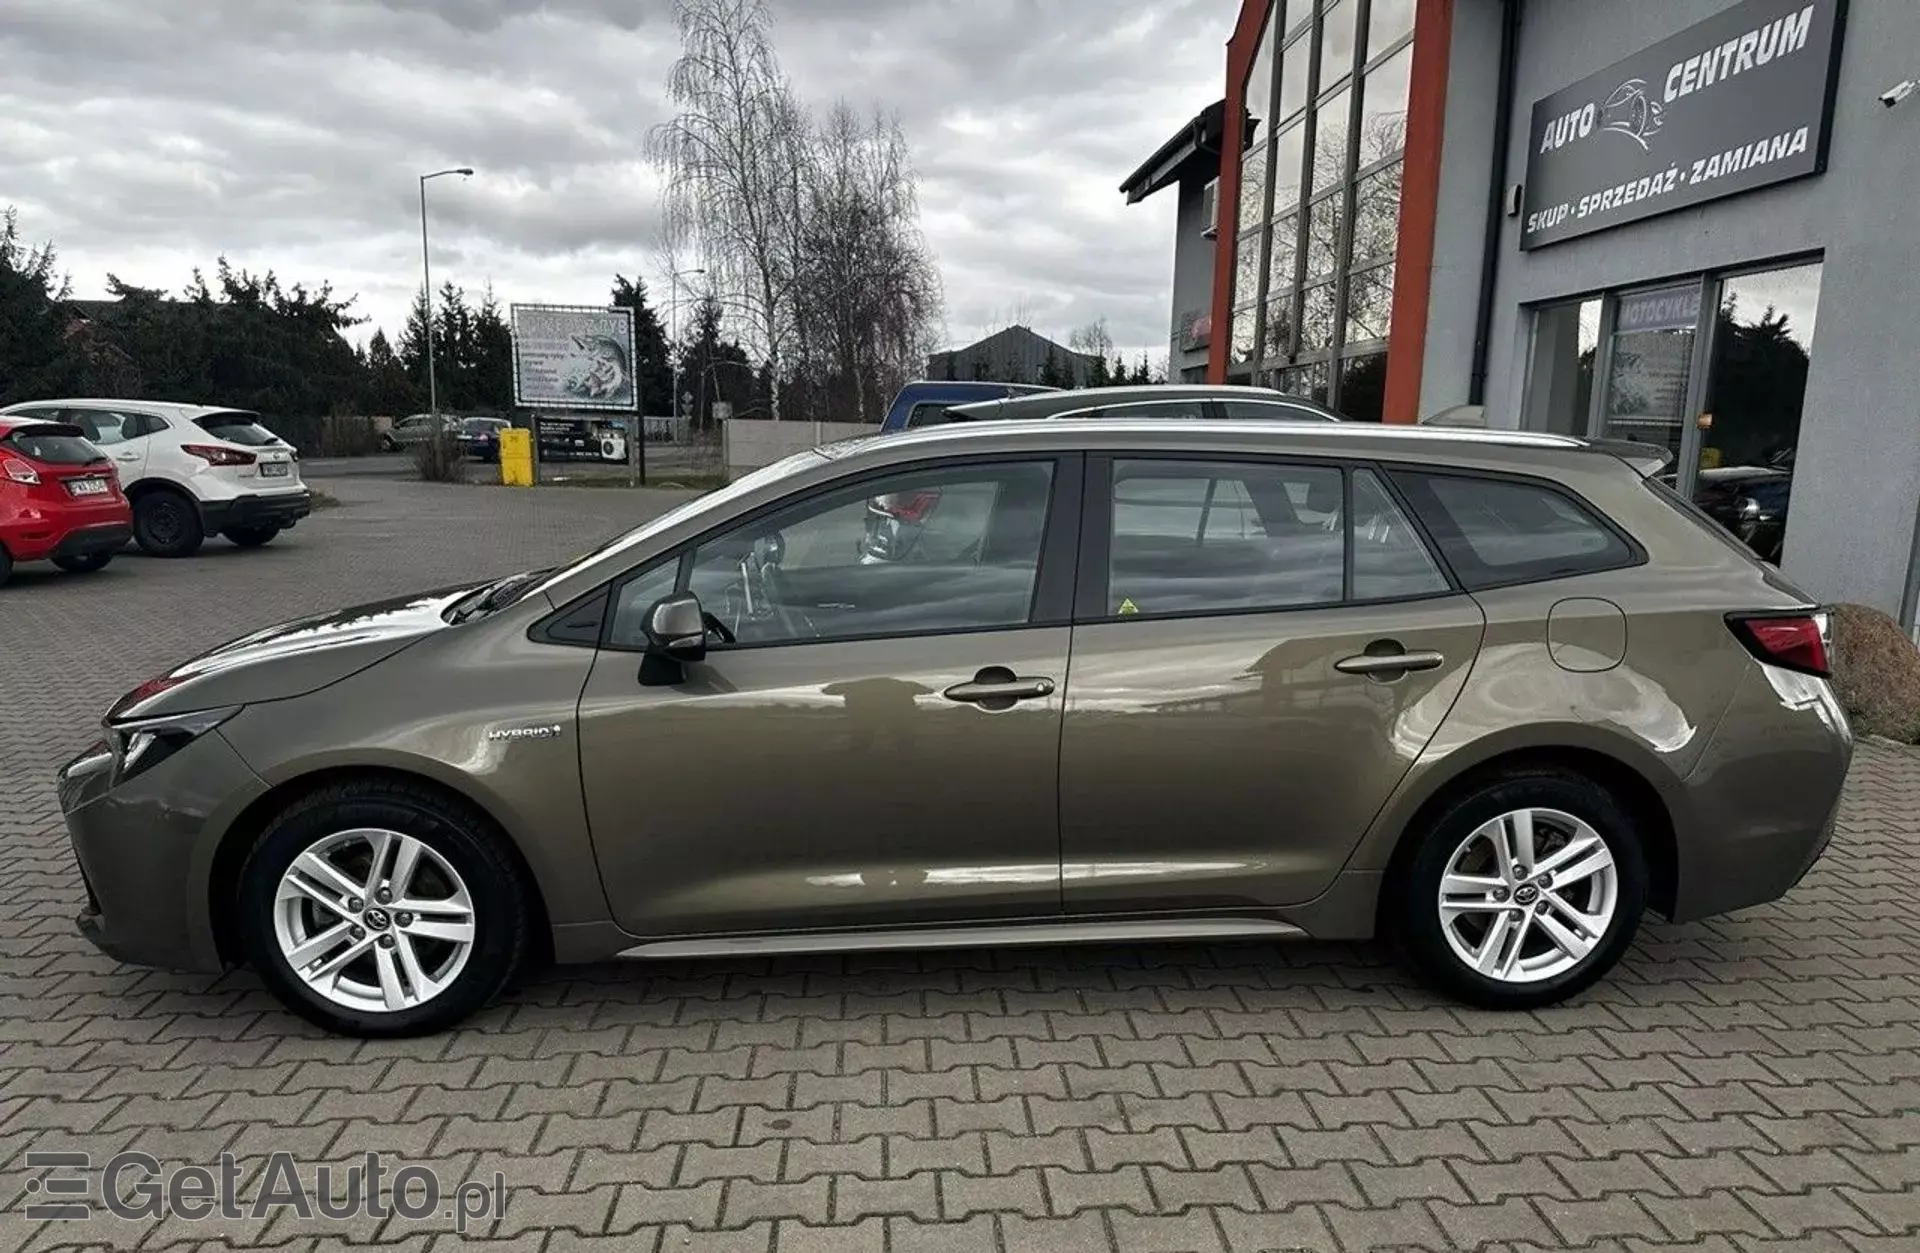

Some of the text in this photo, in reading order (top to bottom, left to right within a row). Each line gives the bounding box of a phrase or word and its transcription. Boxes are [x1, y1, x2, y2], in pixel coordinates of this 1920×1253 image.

[1540, 5, 1815, 154] AUTO CENTRUM
[1526, 126, 1810, 234] SKUP SPRZEDAŻ ZAMIANA
[488, 727, 549, 739] HYBRID
